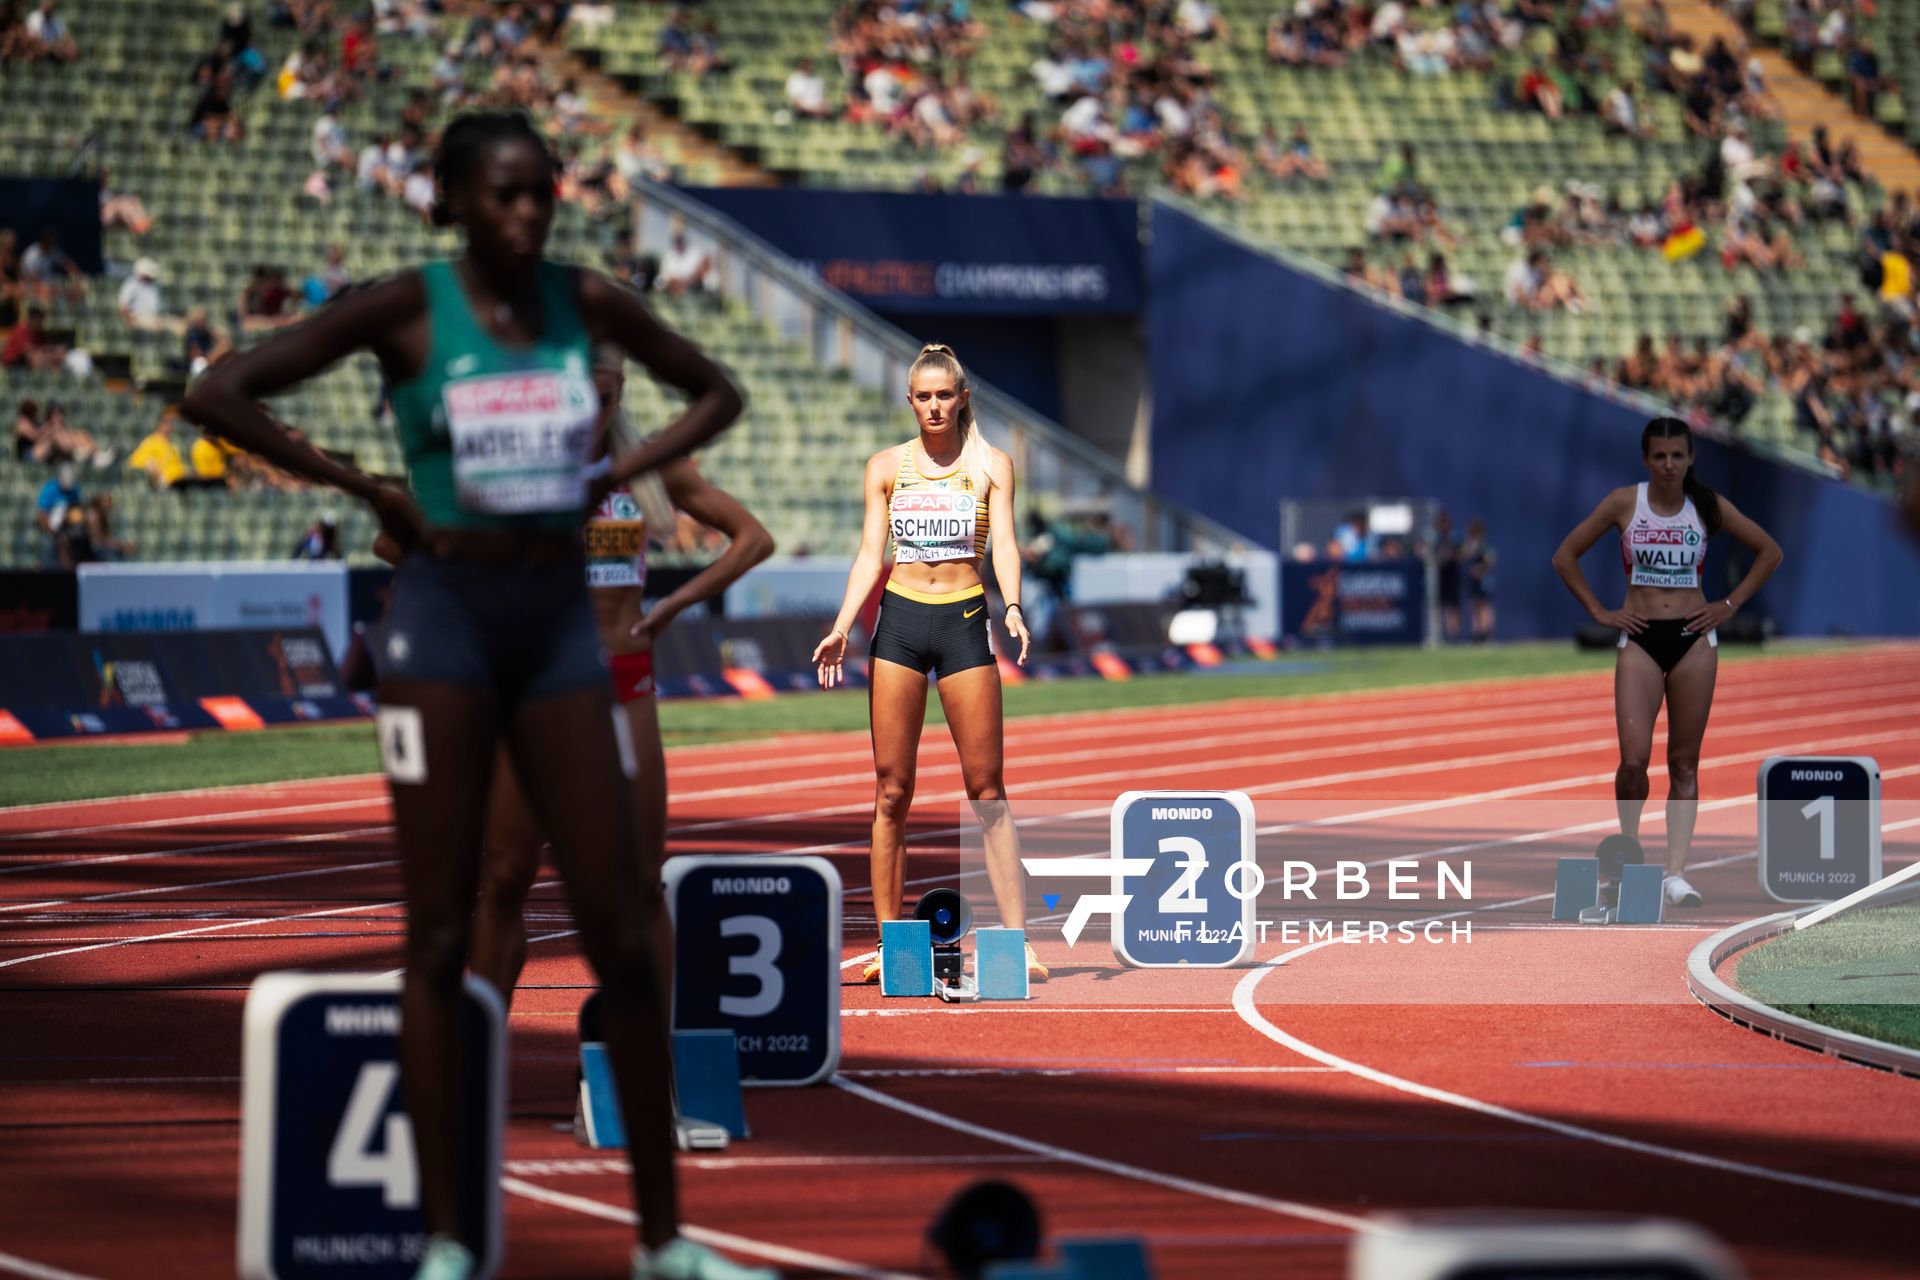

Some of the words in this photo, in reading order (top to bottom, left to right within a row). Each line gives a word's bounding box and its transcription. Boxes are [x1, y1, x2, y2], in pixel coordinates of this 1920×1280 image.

[936, 263, 1106, 300] CHAMPIONSHIPS
[893, 494, 952, 511] SPAR
[895, 519, 972, 537] SCHMIDT
[1633, 530, 1683, 544] SPAR
[901, 549, 939, 559] MUNICH
[943, 545, 969, 556] 2022
[1635, 550, 1695, 566] WALLI
[1635, 574, 1671, 585] MUNICH
[1673, 575, 1693, 585] 2022
[1791, 770, 1844, 781] MONDO
[1152, 808, 1212, 820] MONDO
[1801, 795, 1834, 859] 1
[1159, 837, 1207, 913] 2
[1779, 872, 1825, 883] MUNICH
[1828, 873, 1856, 883] 2022
[712, 877, 791, 894] MONDO
[719, 915, 785, 1017] 3
[767, 1035, 809, 1051] 2022
[327, 1062, 420, 1209] 4
